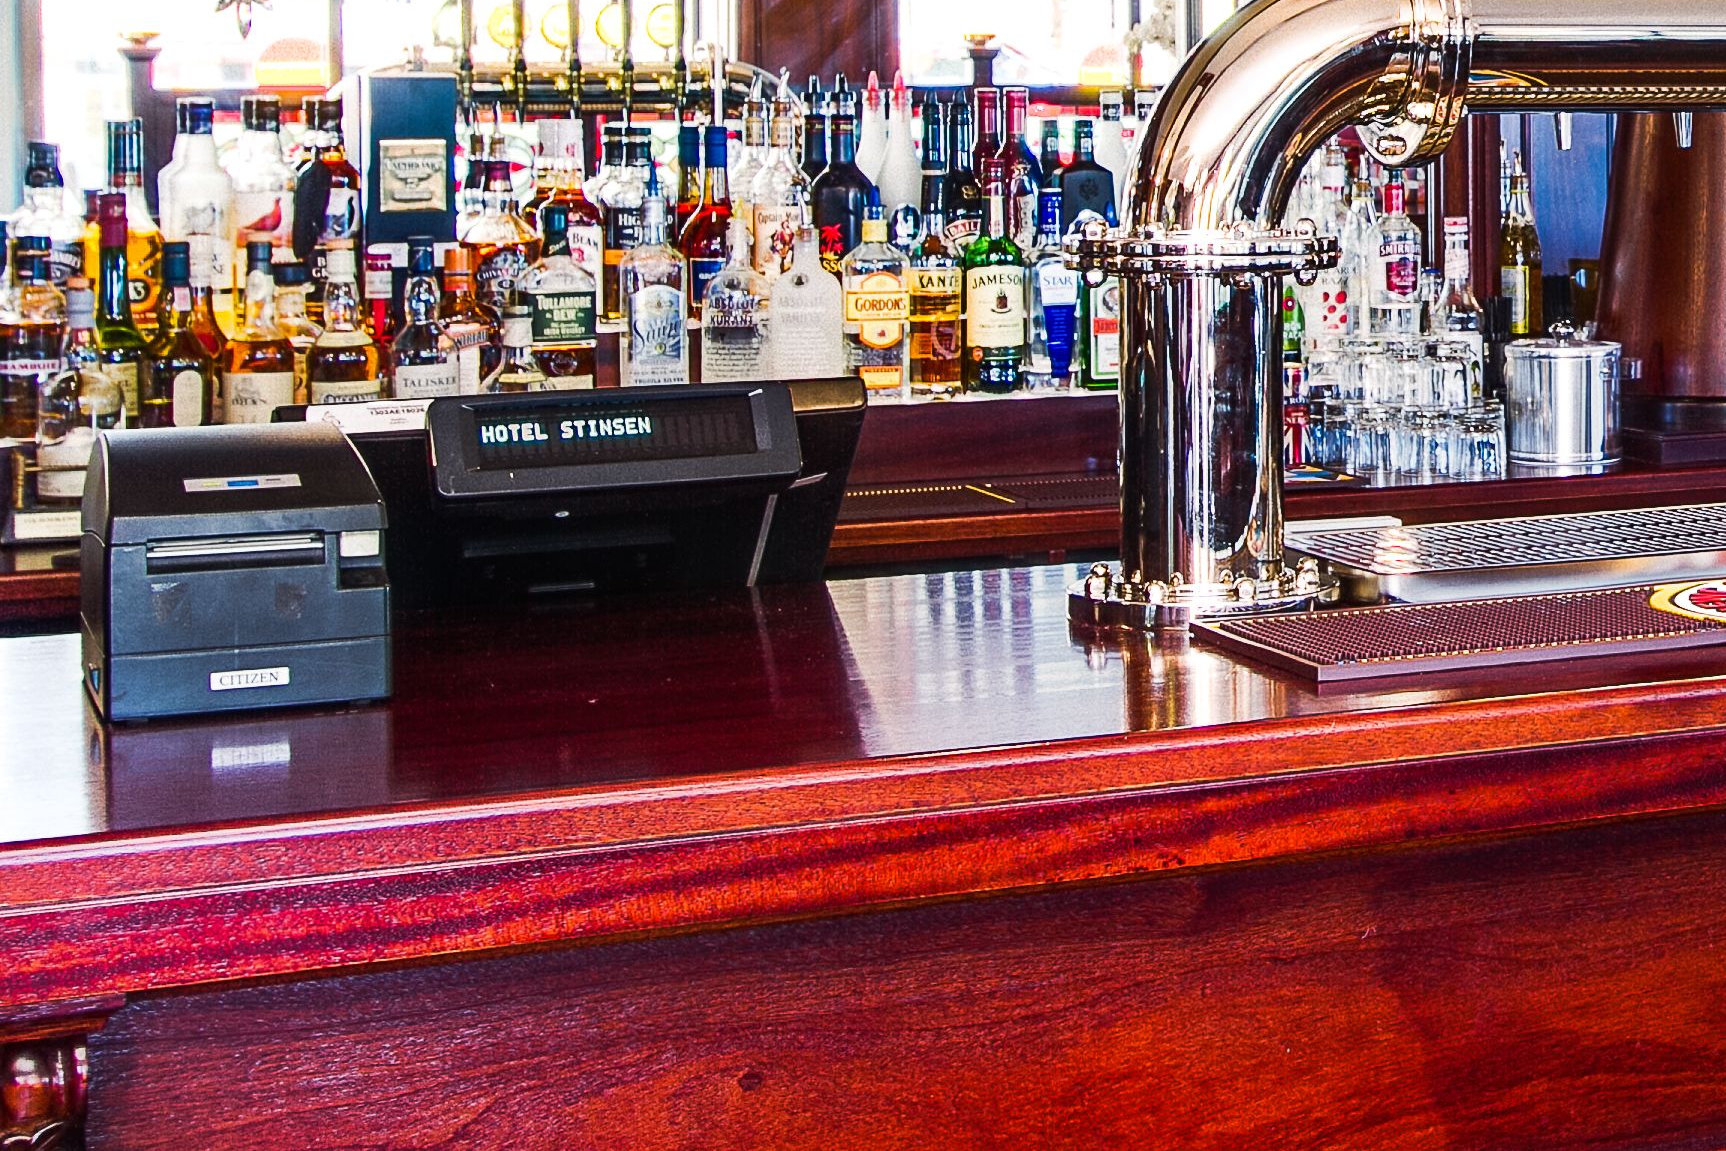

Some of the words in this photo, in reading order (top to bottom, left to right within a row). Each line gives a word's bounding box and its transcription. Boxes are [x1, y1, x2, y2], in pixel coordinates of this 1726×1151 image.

[572, 231, 600, 250] BEAM
[535, 295, 593, 311] TULLAMORE
[480, 422, 549, 444] HOTEL
[559, 416, 652, 440] STINSEN
[219, 671, 279, 687] CITIZEN
